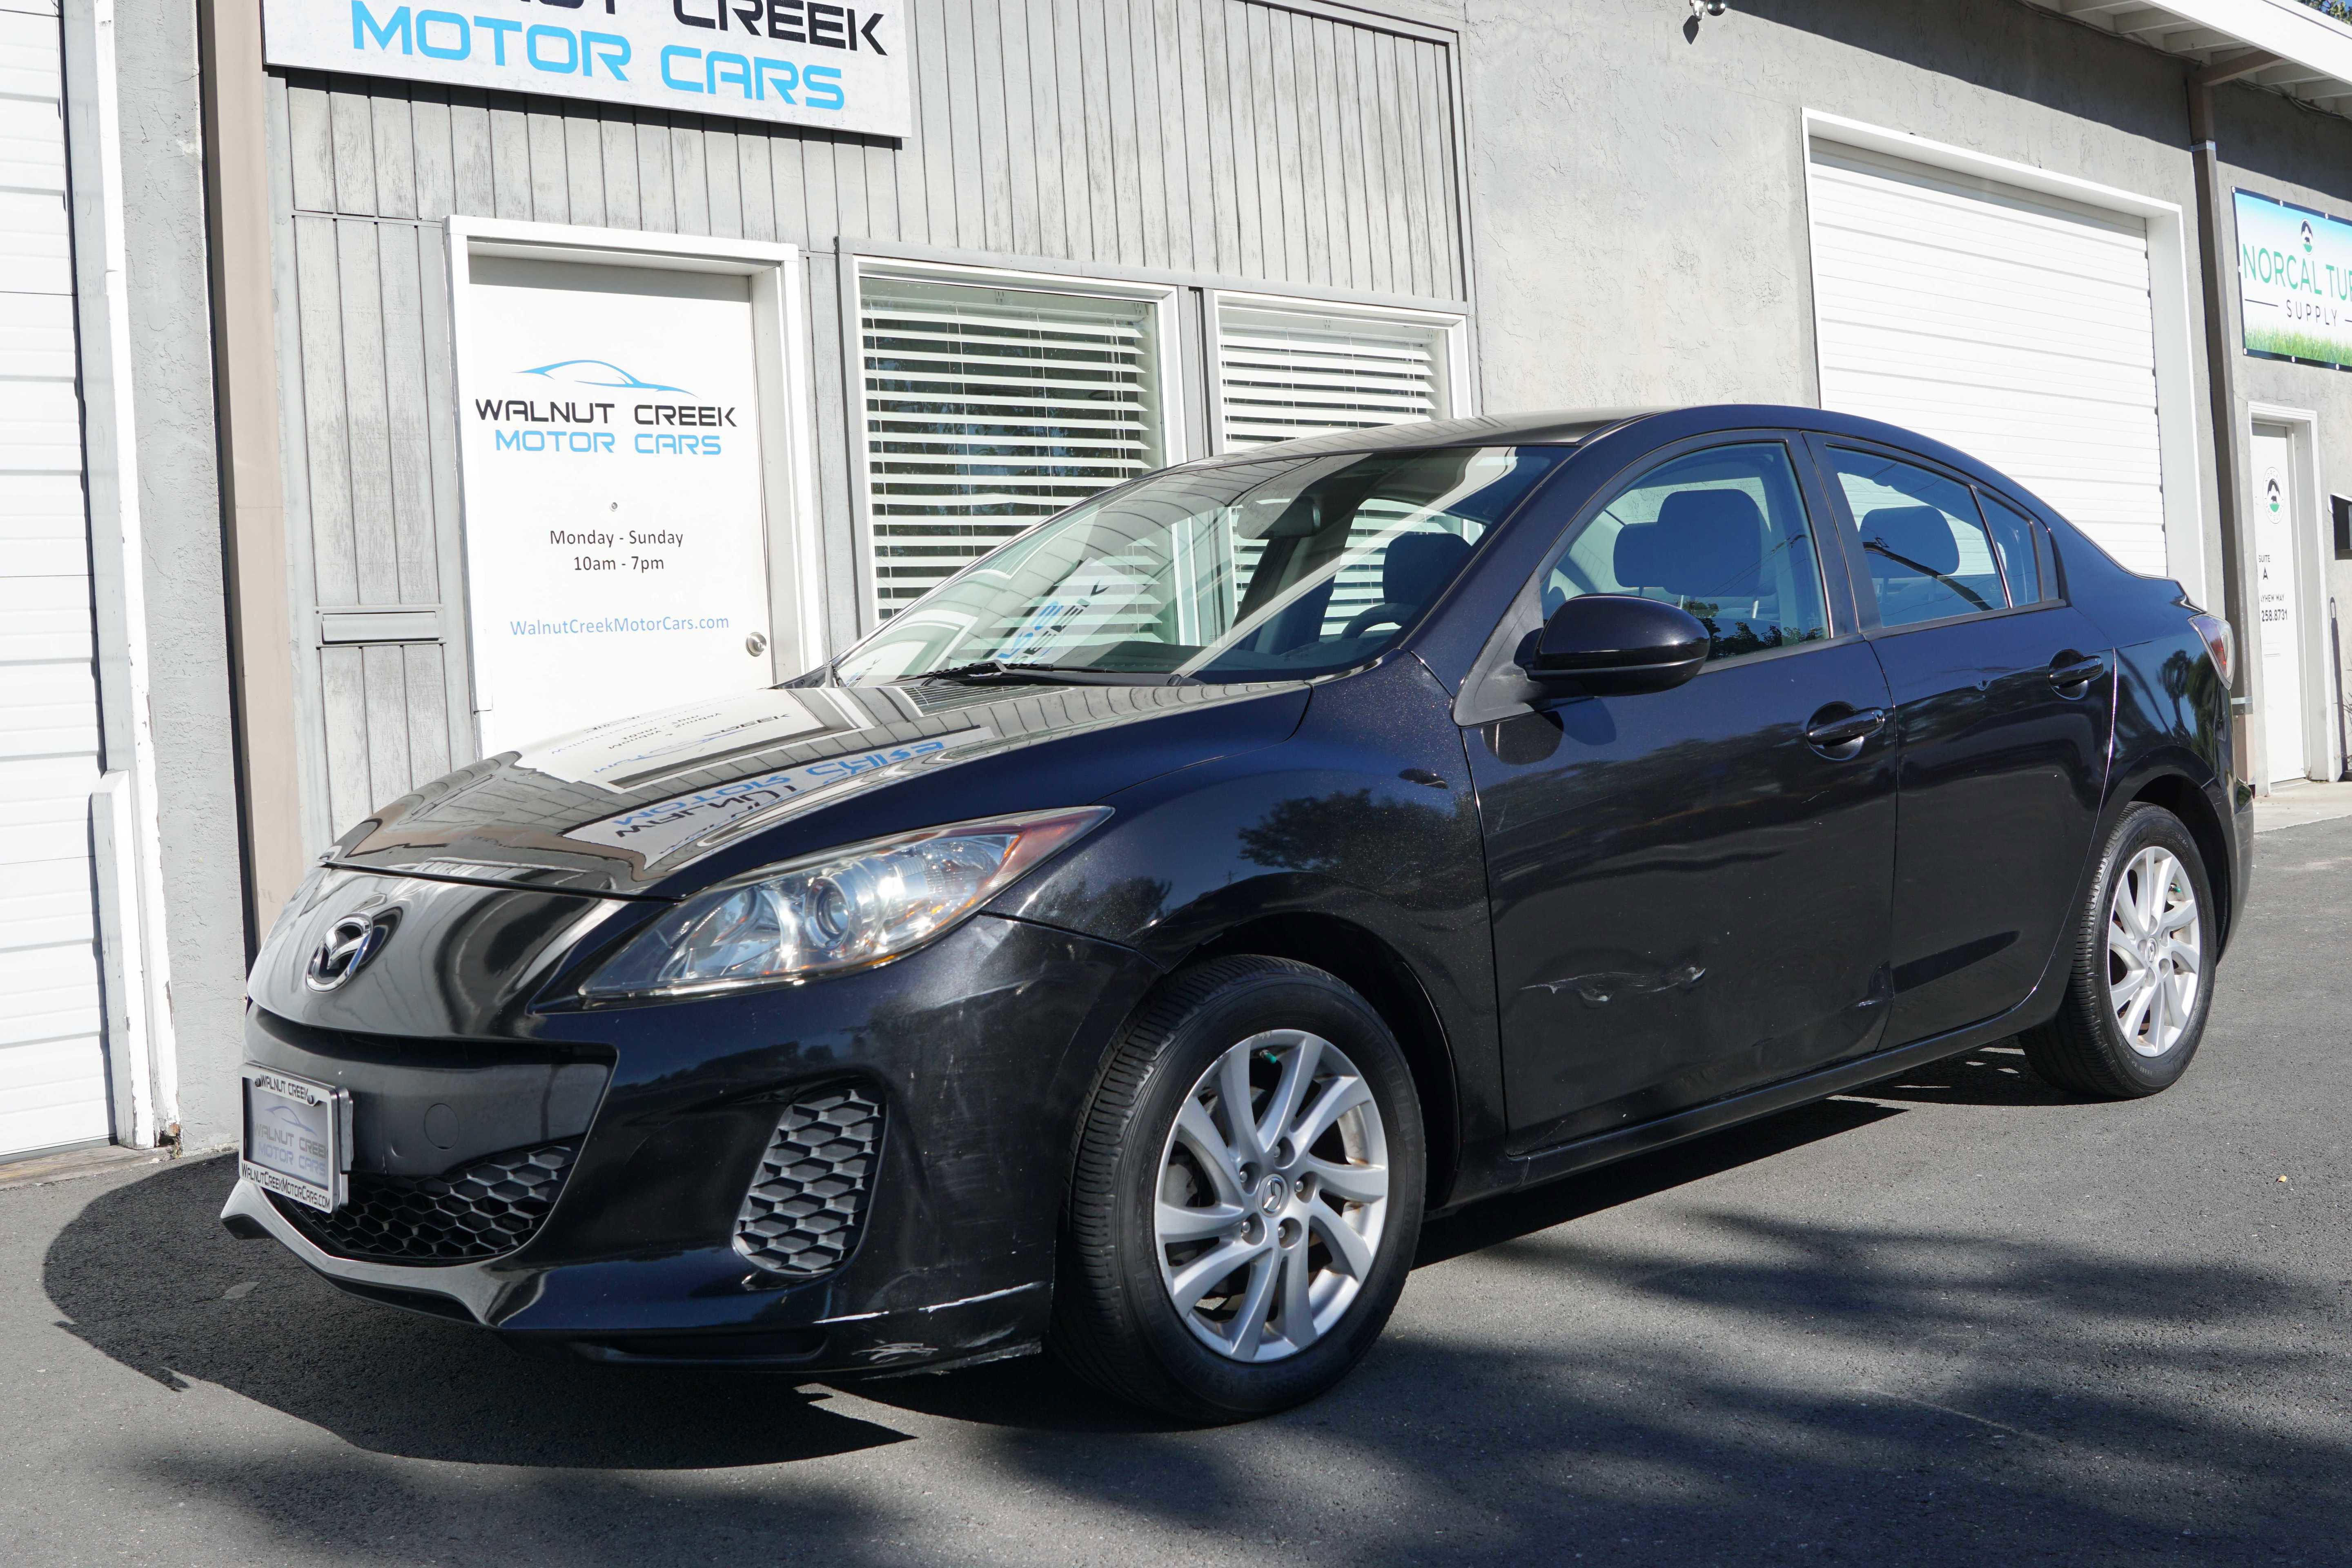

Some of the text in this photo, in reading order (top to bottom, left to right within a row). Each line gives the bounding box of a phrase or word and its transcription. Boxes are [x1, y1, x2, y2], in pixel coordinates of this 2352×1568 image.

[351, 0, 844, 110] MOTOR CARS
[2243, 244, 2322, 295] NORCAL
[2287, 299, 2337, 326] SUPPLY
[476, 399, 737, 427] WALNUT CREEK
[496, 430, 721, 455] MOTOR CARS
[550, 530, 614, 548] Monday
[629, 530, 683, 547] Sunday
[575, 557, 615, 570] 10am
[631, 556, 664, 573] 7pm
[2263, 566, 2268, 579] A
[510, 617, 728, 635] WalnutCreekMotorCars.com
[261, 1074, 308, 1100] WALNUT CREEK
[254, 1124, 294, 1147] WALNUT
[258, 1142, 326, 1177] MOTOR CARS
